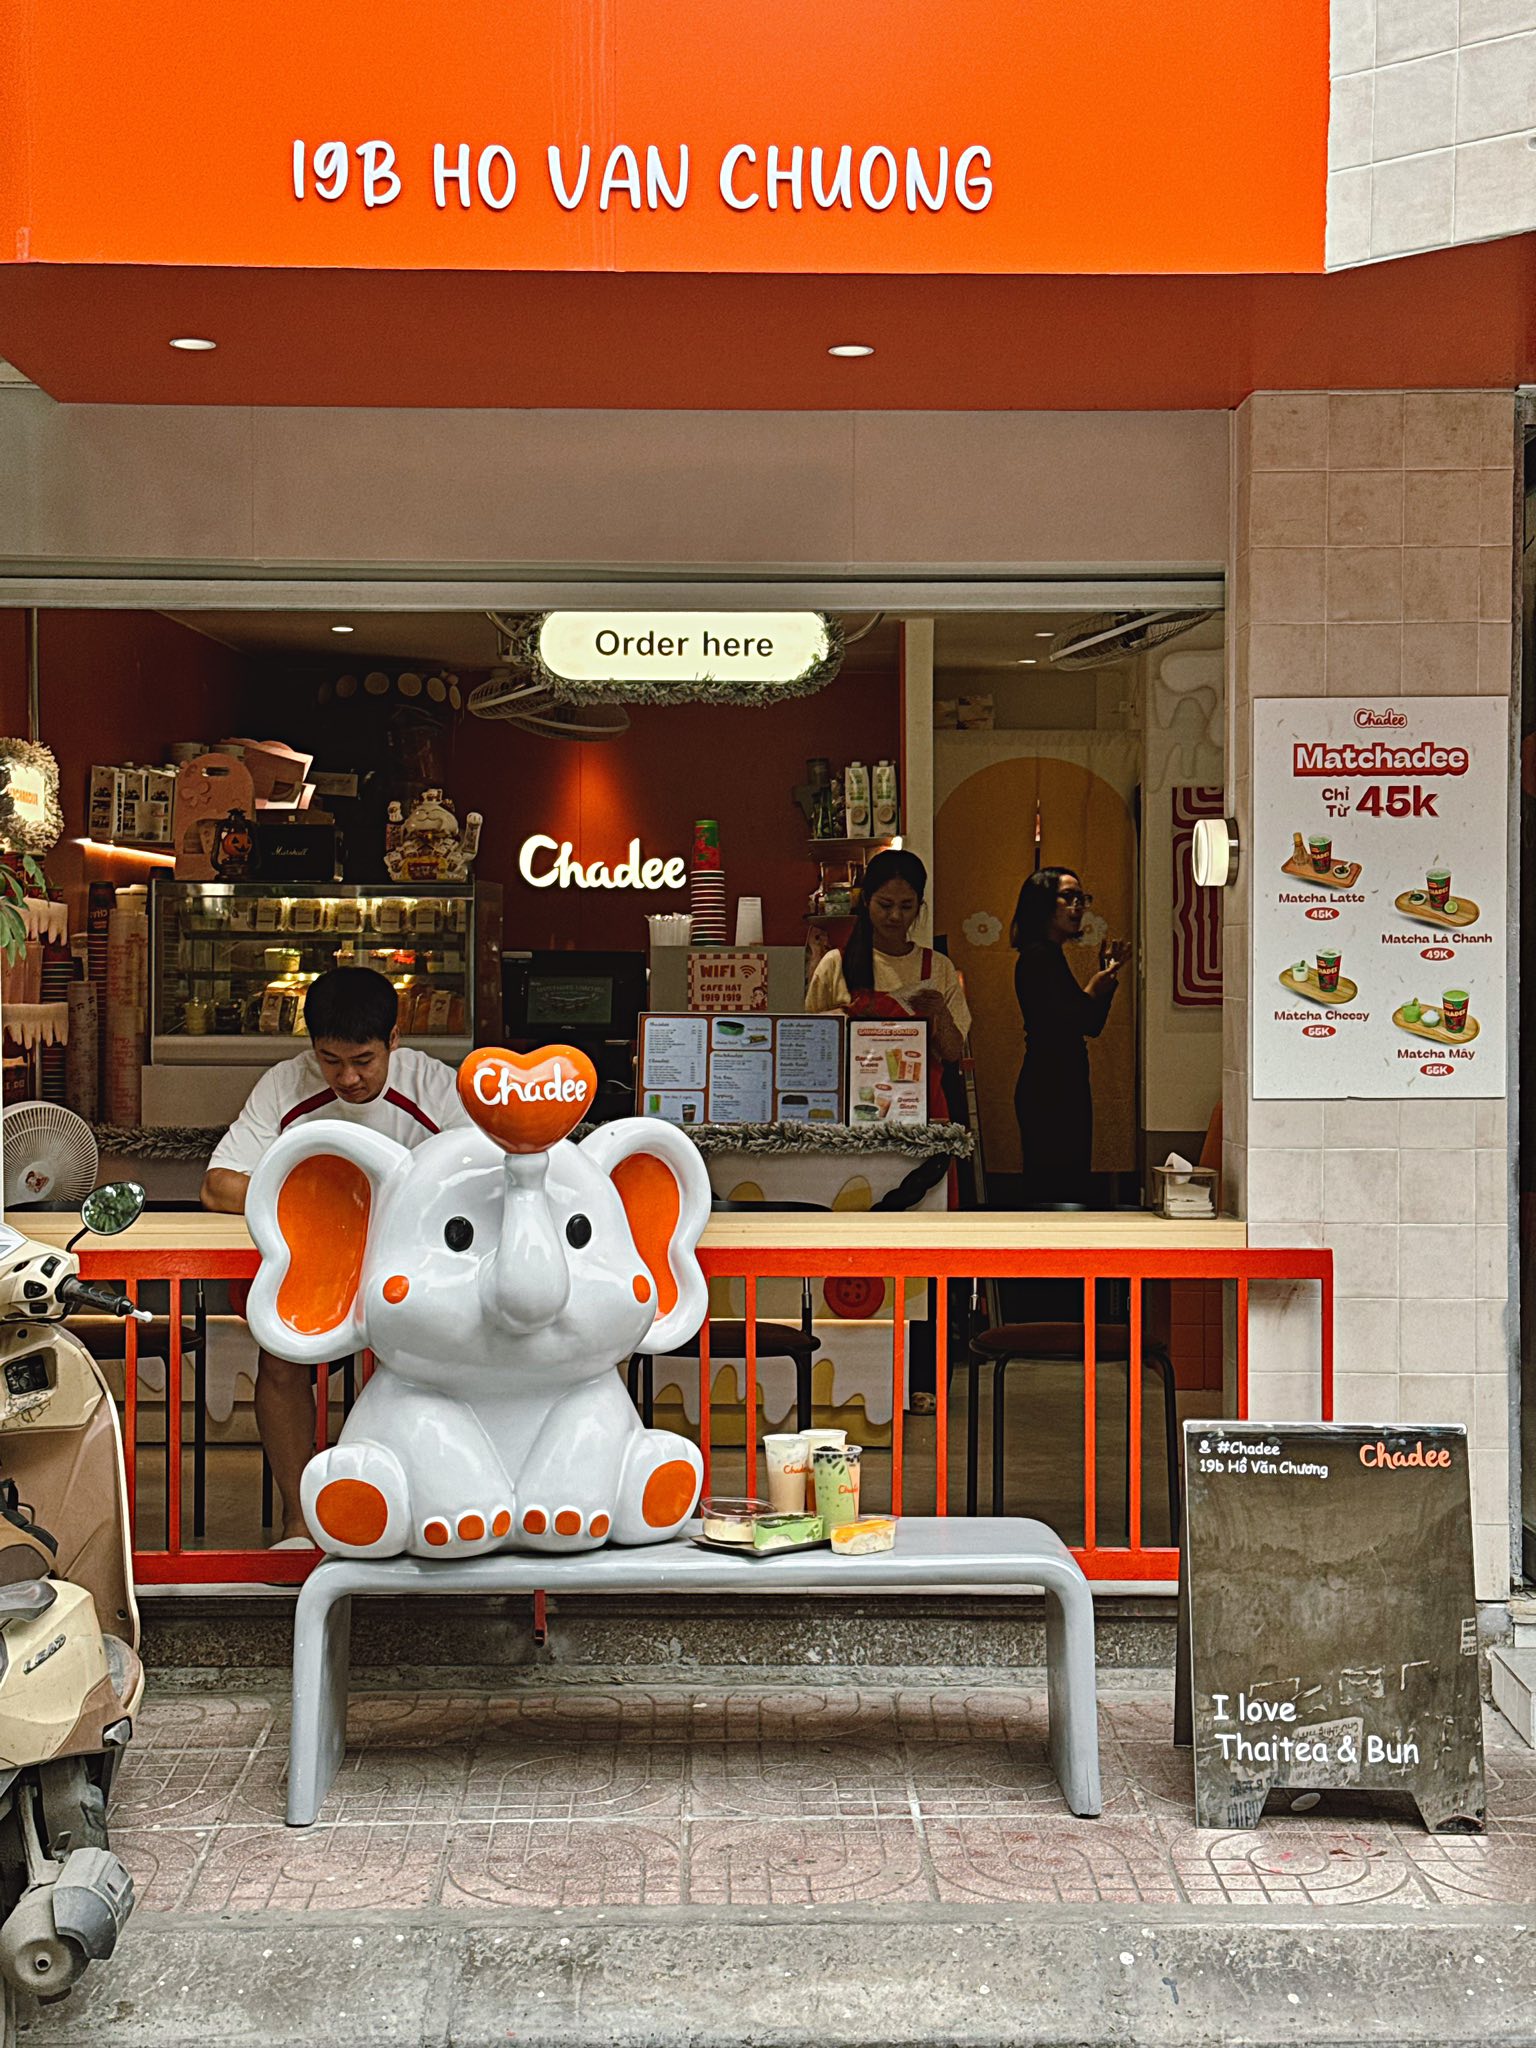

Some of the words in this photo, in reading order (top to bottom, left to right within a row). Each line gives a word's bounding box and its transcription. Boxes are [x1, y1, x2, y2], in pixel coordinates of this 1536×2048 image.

[293, 139, 402, 208] 19B
[433, 143, 517, 209] HO
[547, 143, 689, 211] VAN
[719, 143, 993, 212] CHUONG
[595, 629, 689, 657] Order
[703, 630, 774, 657] here
[1355, 708, 1407, 728] Chadee
[1295, 743, 1467, 772] Matchadee
[1322, 786, 1350, 801] Chỉ
[1355, 785, 1439, 818] 45k
[1326, 804, 1350, 818] Từ
[518, 834, 687, 890] Chadee
[1279, 893, 1327, 903] Matcha
[1330, 893, 1366, 903] Latte
[1381, 933, 1430, 944] Matcha
[1452, 933, 1493, 944] Chanh
[1426, 950, 1449, 959] 49K
[700, 965, 736, 979] WIFI
[700, 984, 723, 992] CAFE
[701, 993, 720, 1002] 1919
[722, 993, 742, 1002] 1919
[1274, 1010, 1322, 1021] Matcha
[1397, 1049, 1446, 1059] Matcha
[473, 1062, 588, 1106] Chadee
[1217, 1441, 1281, 1456] #Chadee
[1359, 1441, 1452, 1470] Chadee
[1200, 1459, 1225, 1473] 19b
[1228, 1457, 1248, 1473] Hồ
[1212, 1694, 1229, 1721] I
[1239, 1693, 1297, 1722] love
[1214, 1732, 1329, 1763] Thaitea
[1337, 1735, 1358, 1764] &
[1367, 1735, 1420, 1765] Bun
